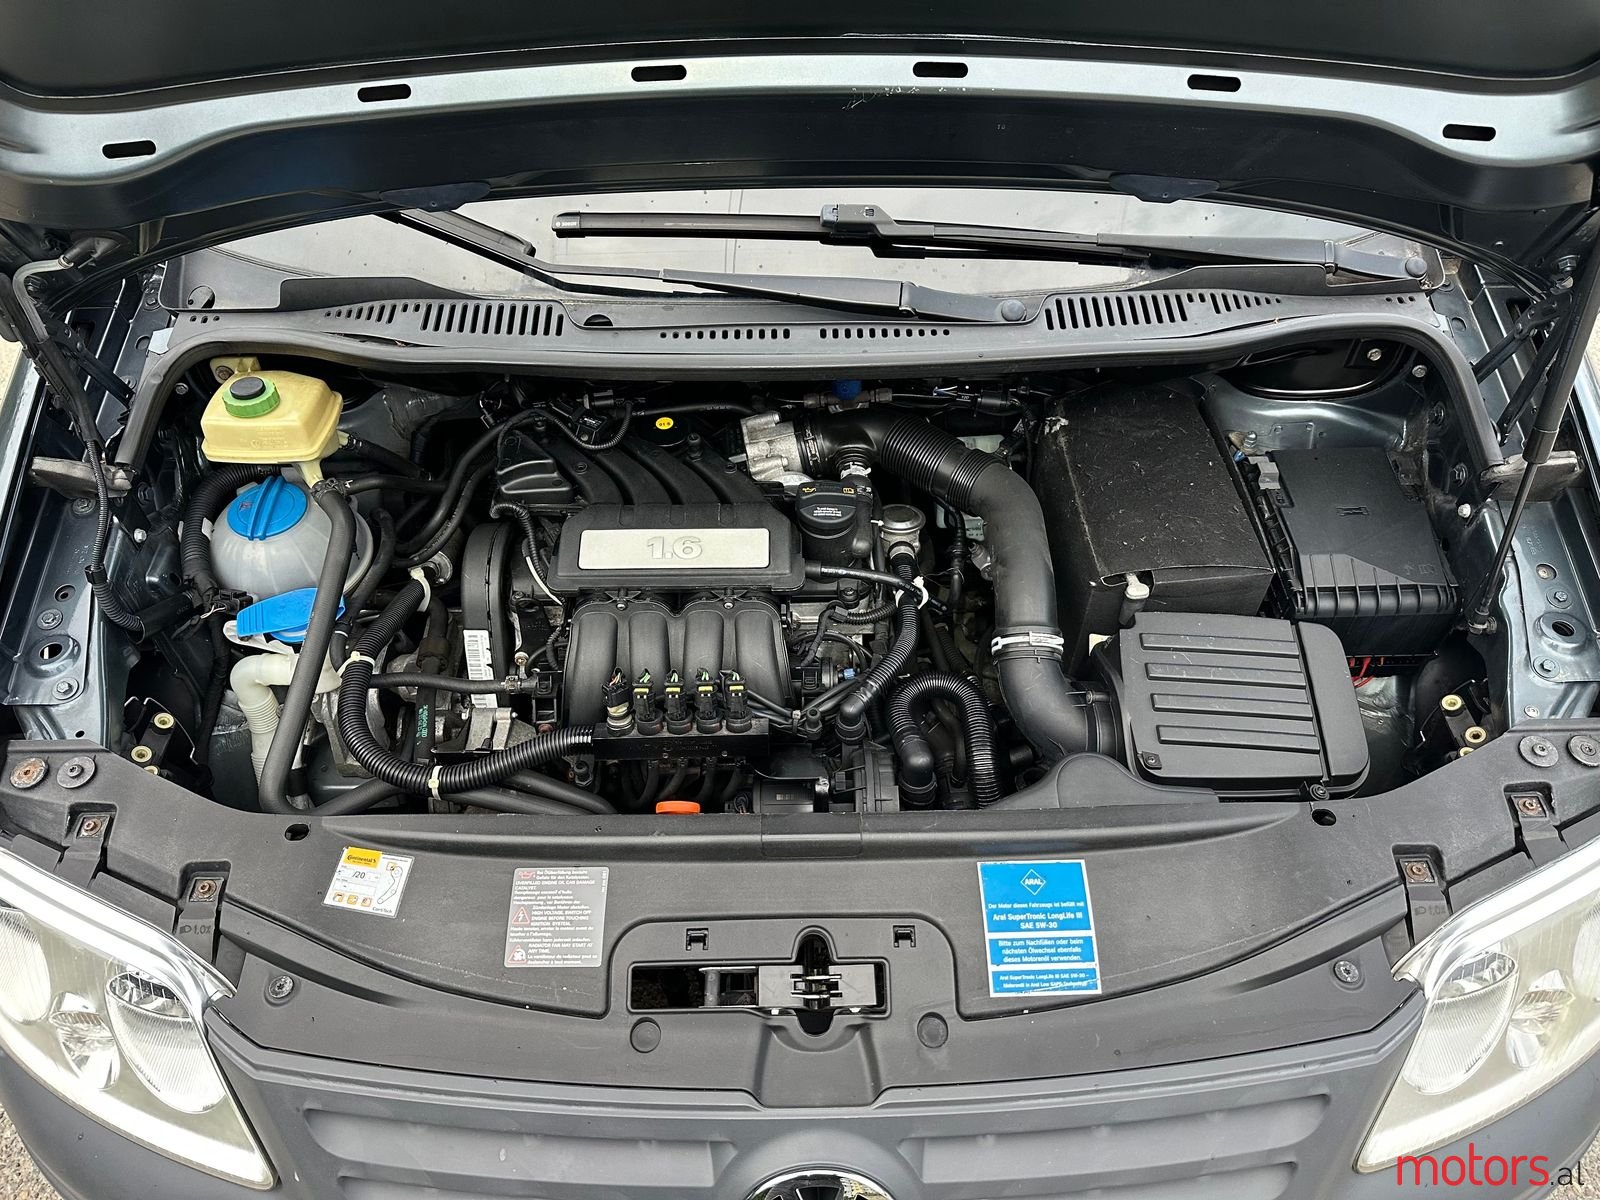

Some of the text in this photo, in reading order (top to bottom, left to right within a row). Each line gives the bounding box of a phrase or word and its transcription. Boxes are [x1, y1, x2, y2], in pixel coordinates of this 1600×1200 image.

[647, 536, 703, 560] 1.6
[1008, 912, 1046, 921] SuperTronic
[1047, 912, 1074, 920] LongLife
[1035, 921, 1058, 929] 5W-30
